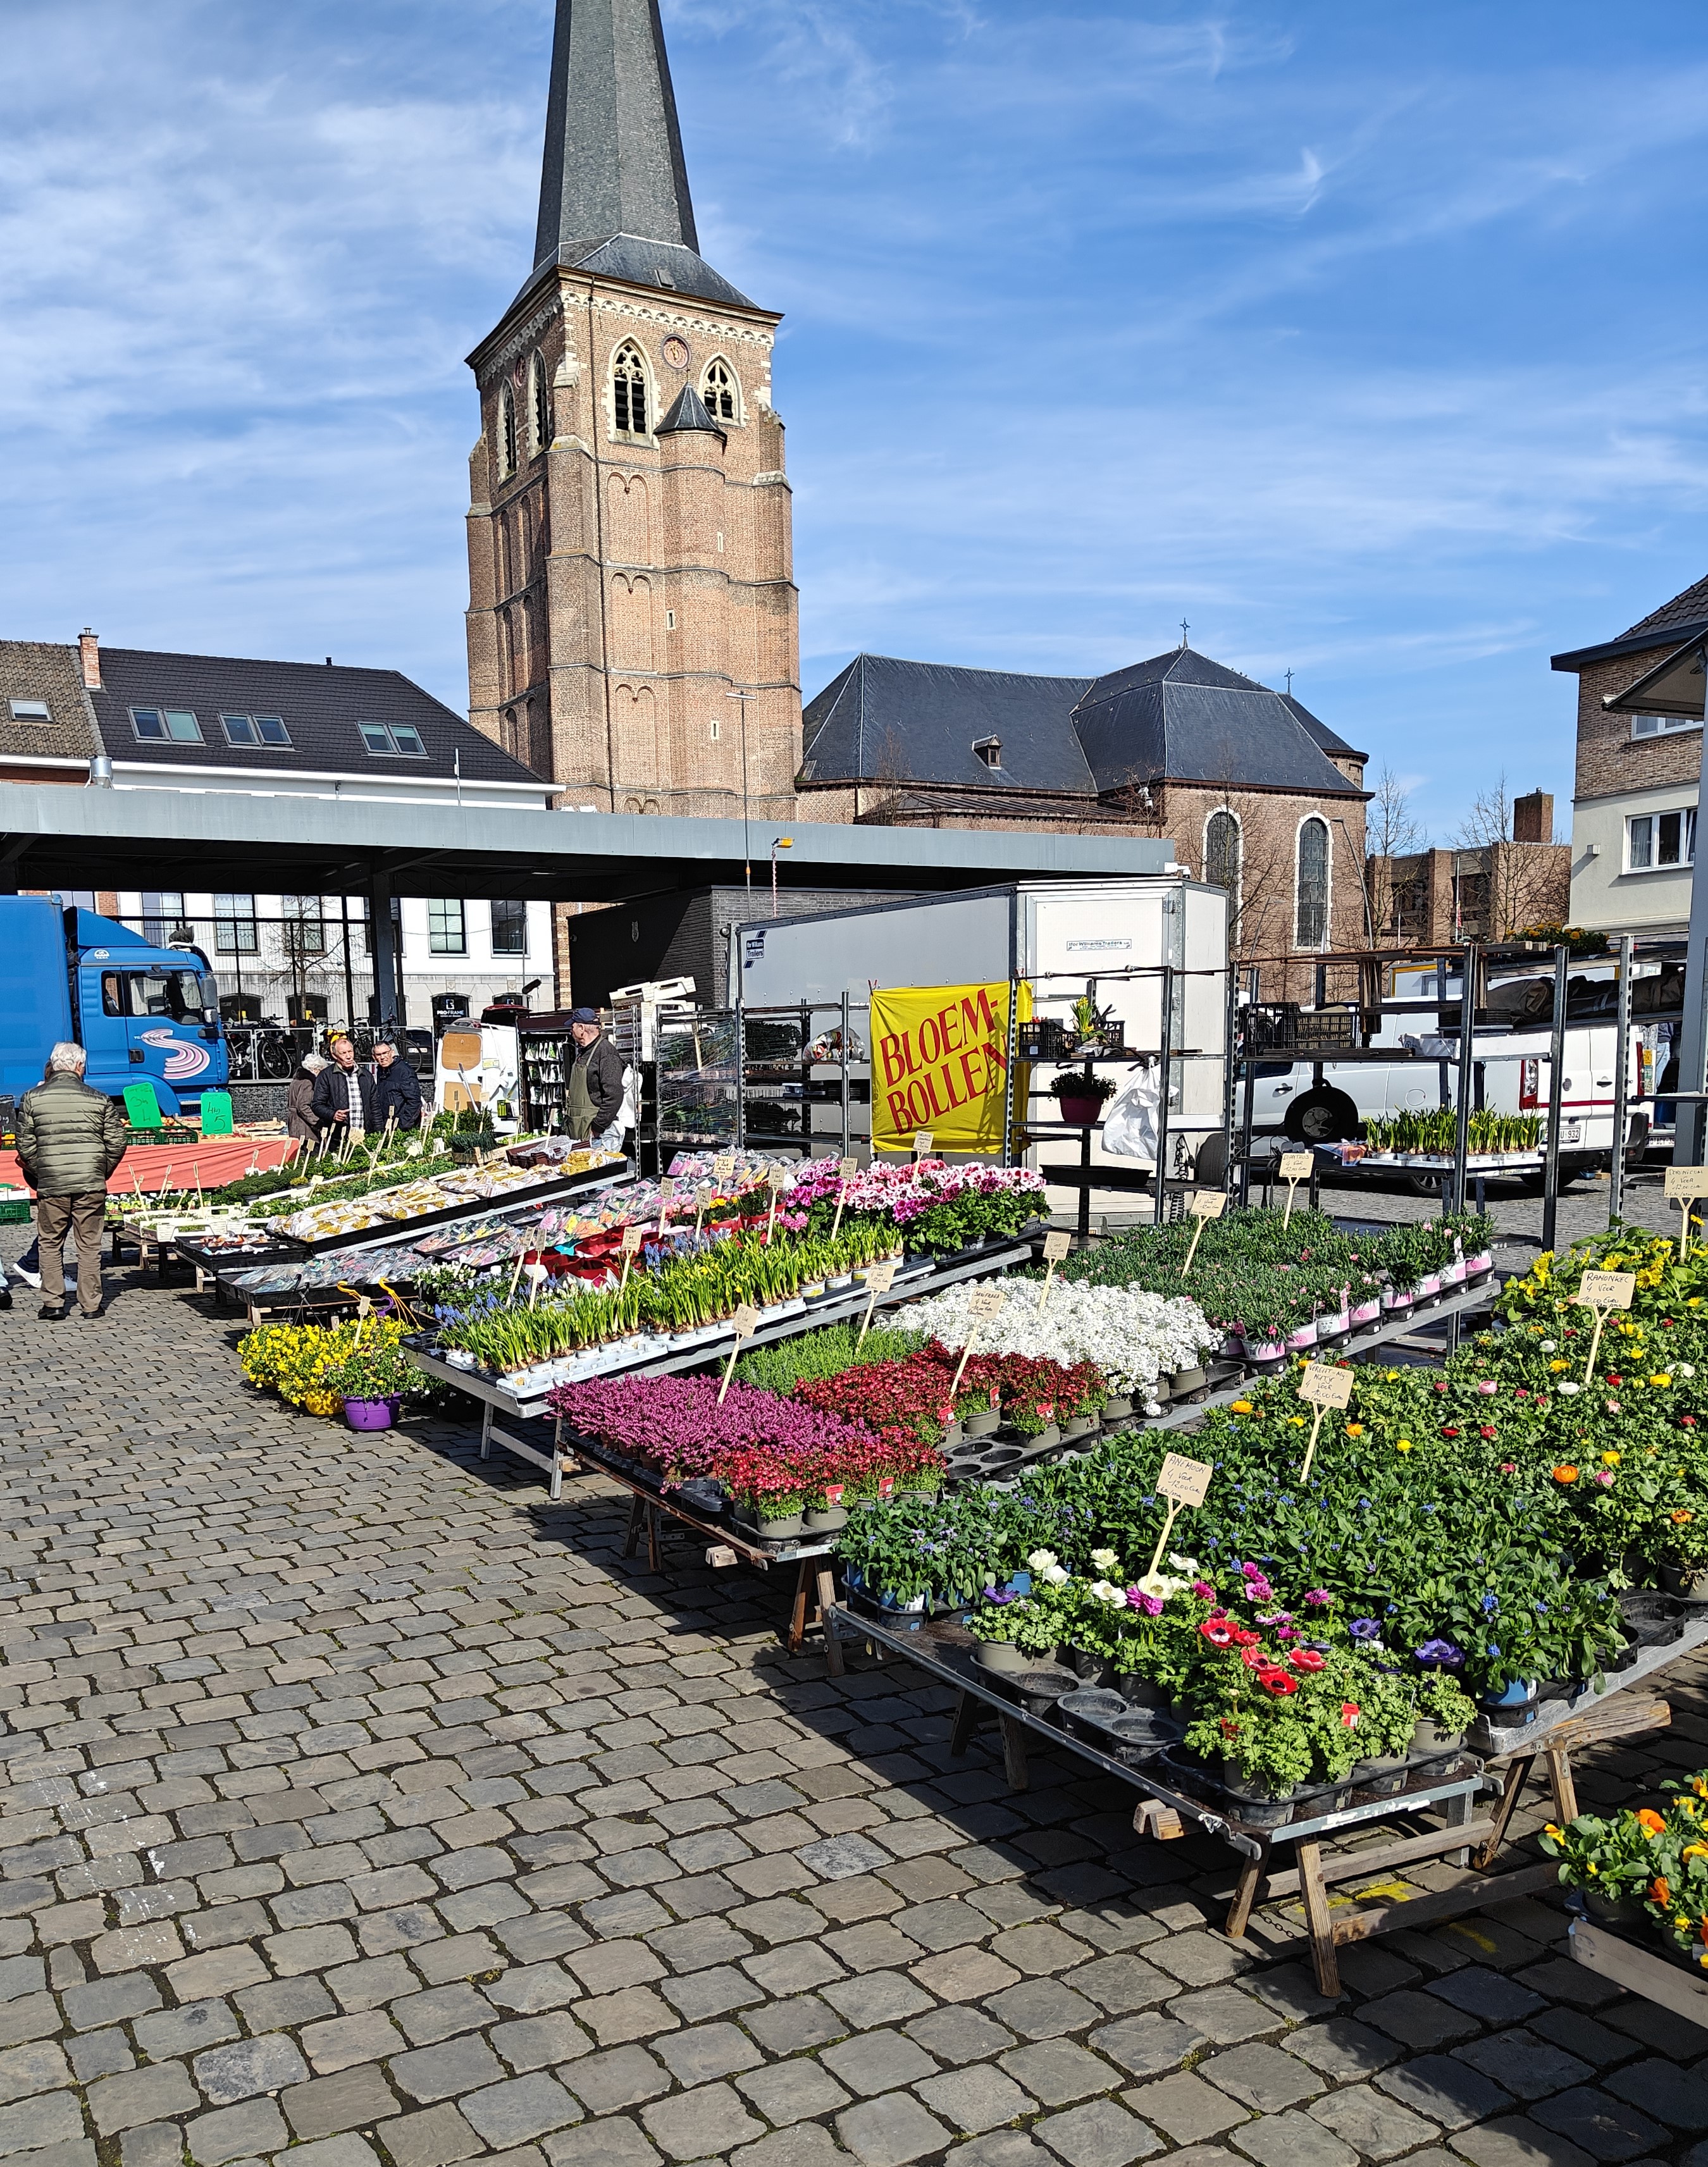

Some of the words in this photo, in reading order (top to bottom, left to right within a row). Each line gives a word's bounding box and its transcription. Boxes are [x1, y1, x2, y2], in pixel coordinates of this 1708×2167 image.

[879, 988, 998, 1089] BLOEM-
[886, 1034, 1007, 1137] BOLLEN
[214, 1115, 226, 1131] 5
[1587, 1272, 1629, 1283] RANONKEL
[1587, 1282, 1593, 1292] 4
[1168, 1455, 1206, 1473] ANEMOON
[1167, 1468, 1173, 1479] 4
